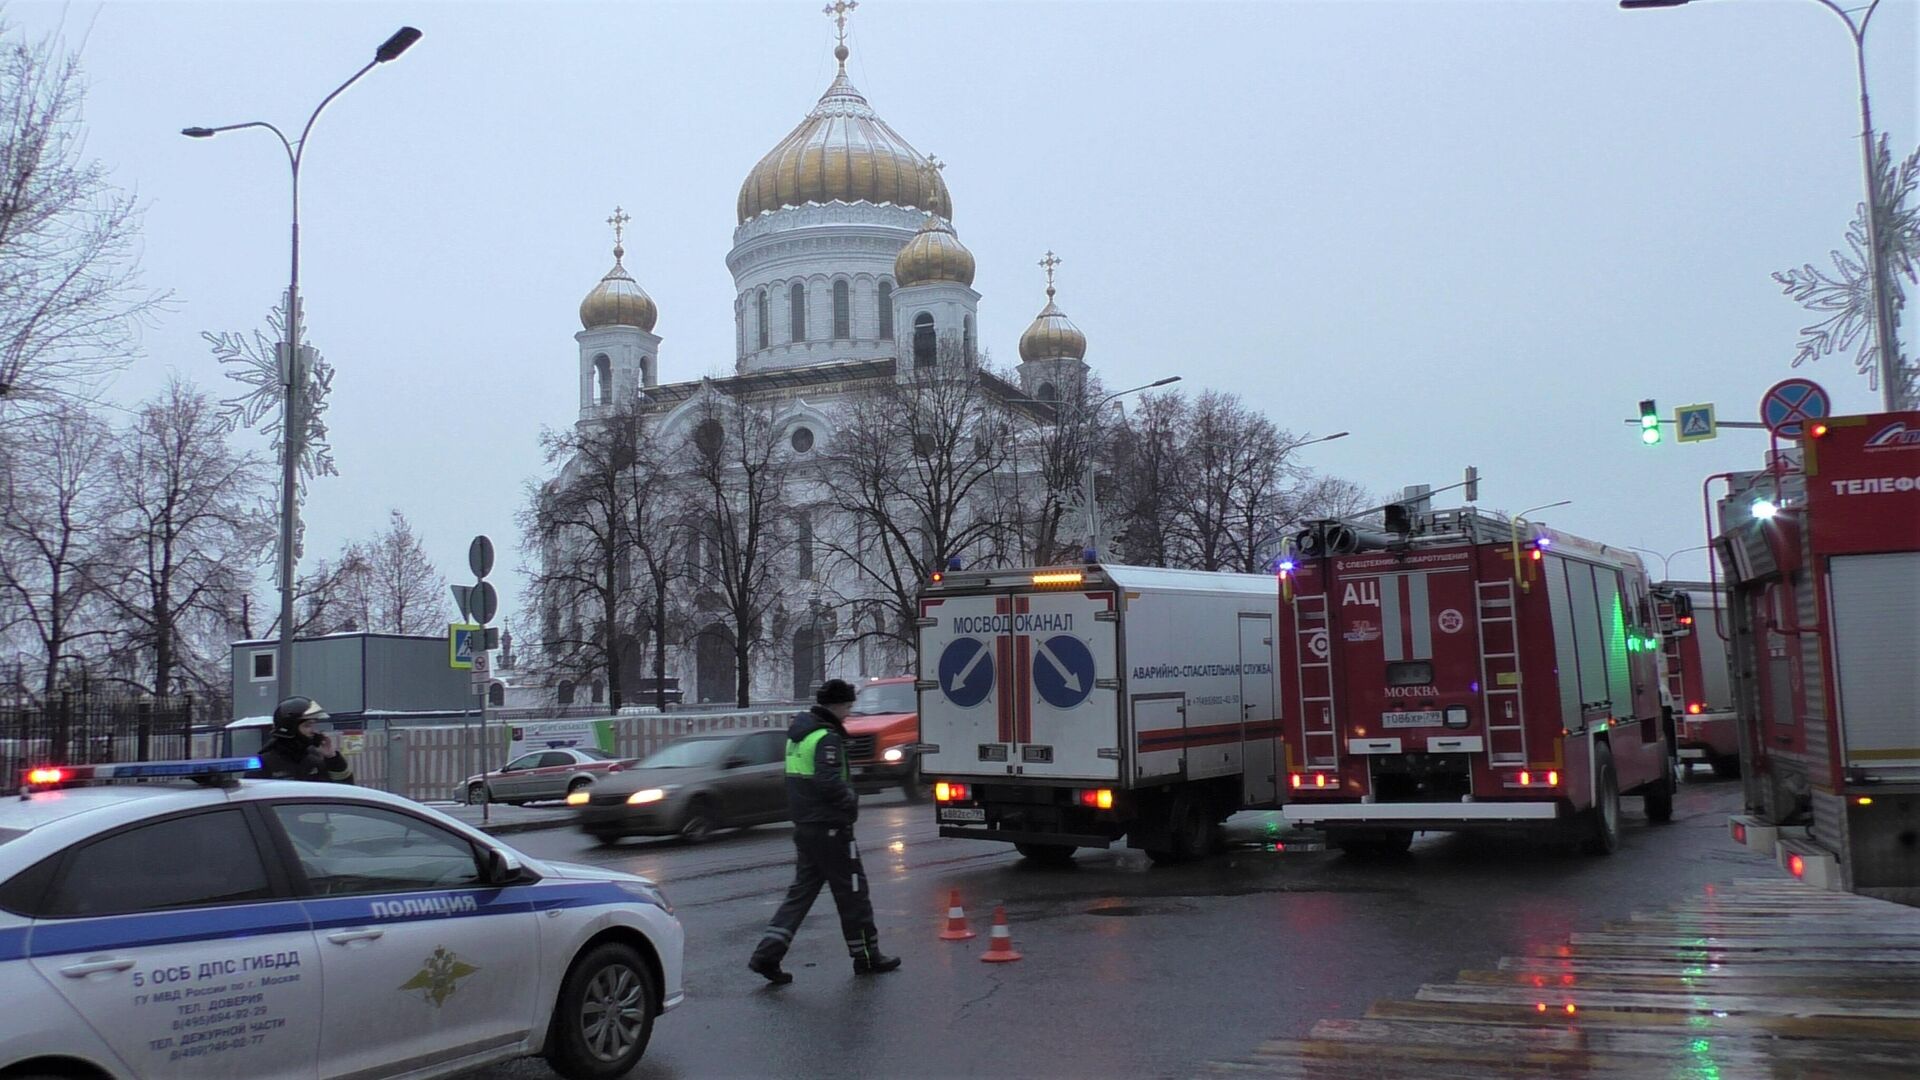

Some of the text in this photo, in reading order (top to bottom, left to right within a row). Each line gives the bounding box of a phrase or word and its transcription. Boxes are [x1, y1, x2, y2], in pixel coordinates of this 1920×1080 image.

[1831, 477, 1920, 495] ТЕЛЕФ
[1342, 581, 1379, 607] АЦ
[953, 613, 1073, 634] МОСВОДОКАНАЛ
[1133, 663, 1272, 679] АВАРИЙНО-СПАСАТЕЛЬНАЯ СЛУЖБА
[1384, 685, 1440, 698] МОСКВА
[371, 895, 478, 918] ПОЛИЦИЯ
[133, 951, 301, 987] 5 ОСБ ДПС ГИБДД
[134, 995, 149, 1006] ГУ
[153, 988, 181, 1004] МВД
[185, 984, 227, 998] России
[231, 983, 245, 992] по
[261, 973, 300, 987] Москве
[208, 992, 264, 1011] ДОВЕРИЯ
[180, 1023, 246, 1046] ДЕЖУРНОЙ
[250, 1017, 286, 1032] ЧАСТИ
